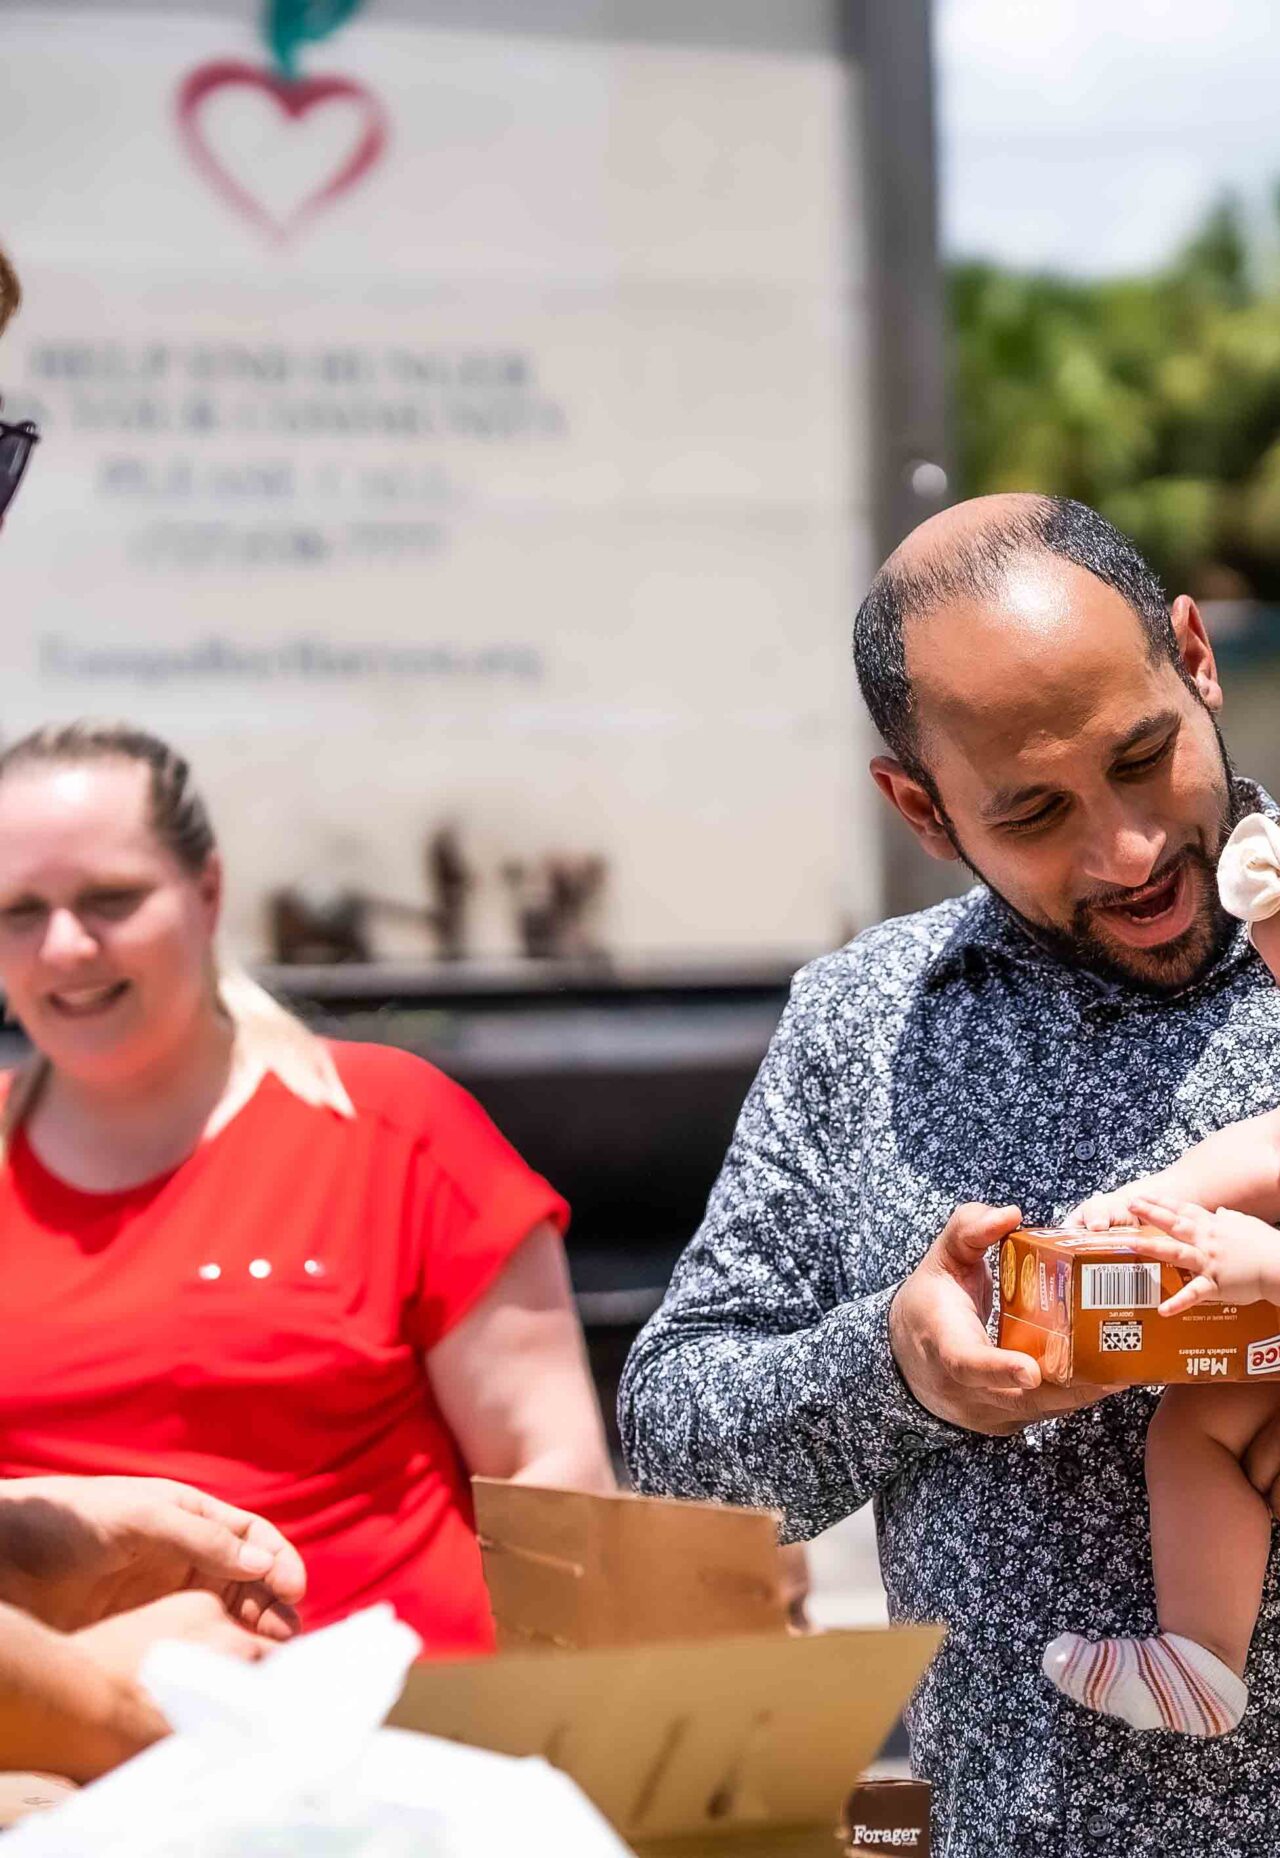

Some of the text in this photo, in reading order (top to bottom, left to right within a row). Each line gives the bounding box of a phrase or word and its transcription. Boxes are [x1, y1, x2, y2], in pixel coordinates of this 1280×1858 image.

[1178, 1348, 1238, 1356] sandwich crackers
[1186, 1357, 1228, 1376] Malt
[853, 1824, 922, 1846] Forager
